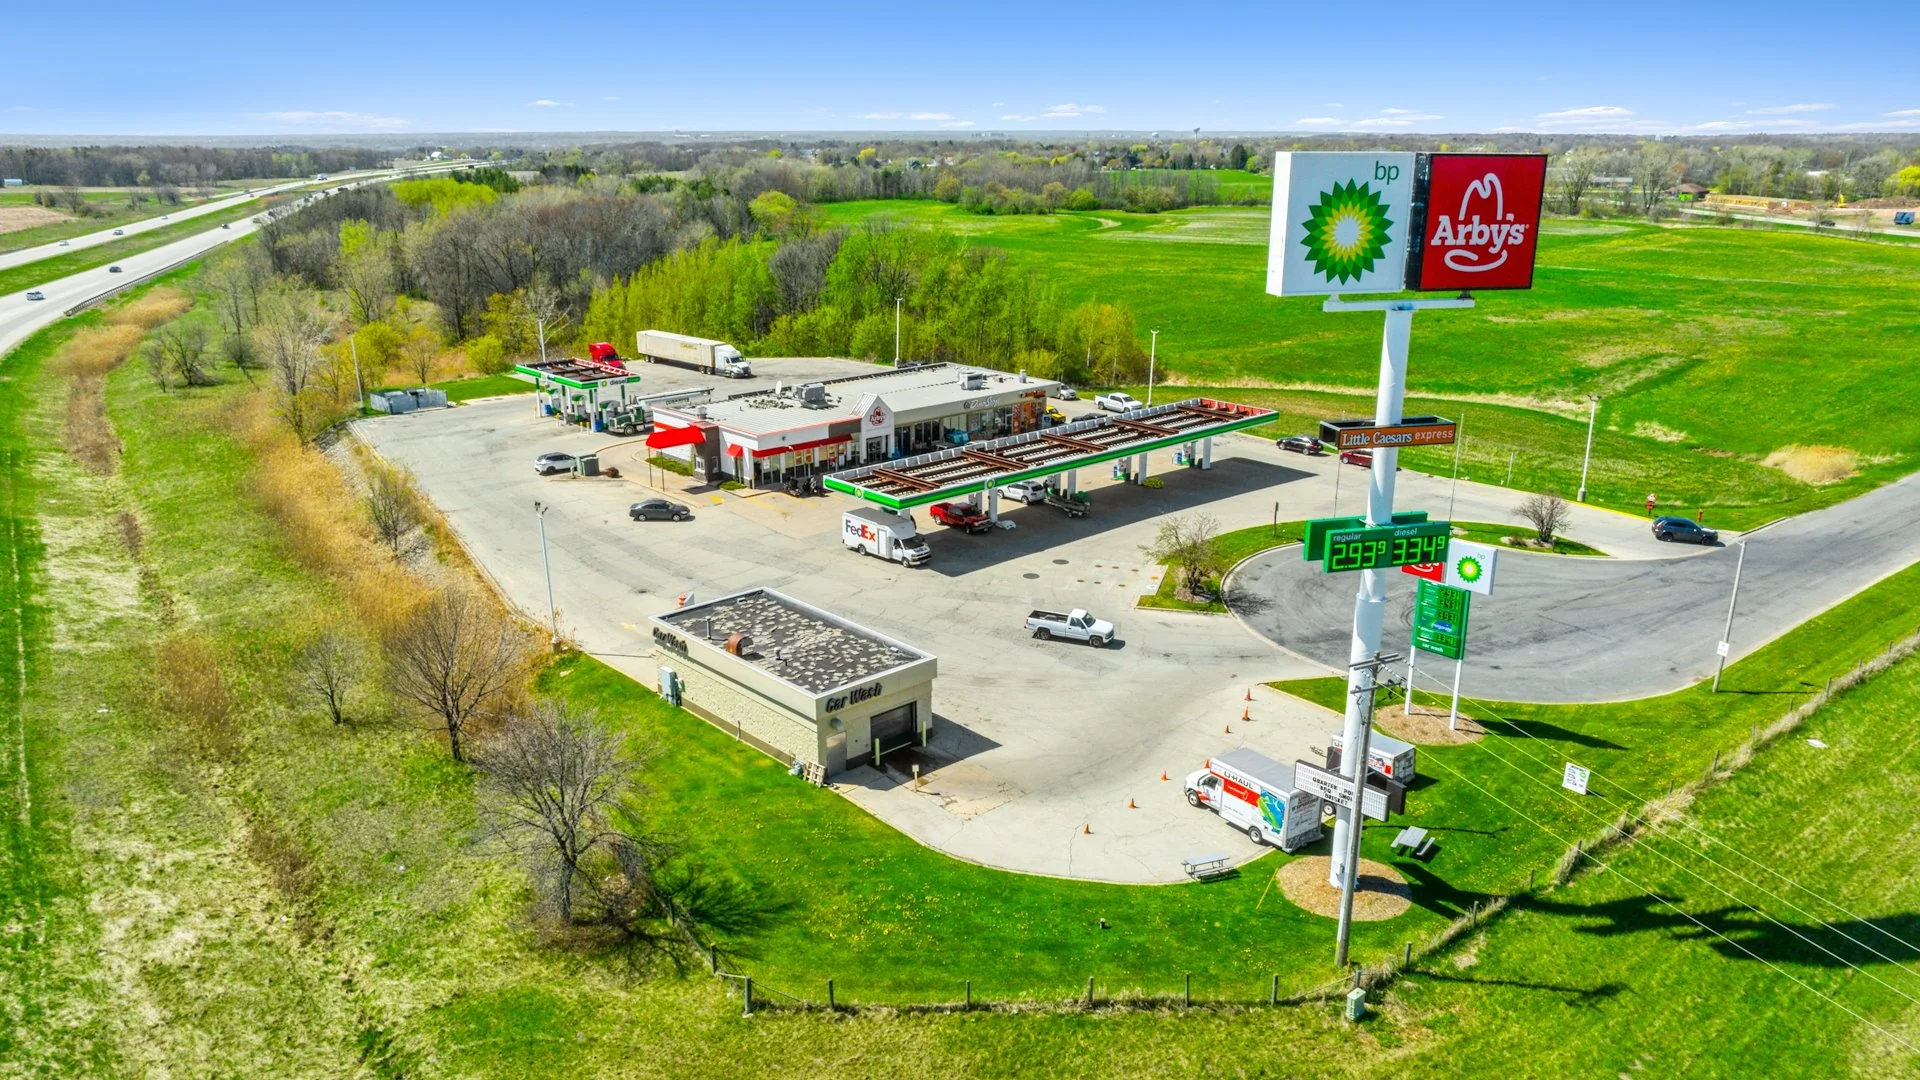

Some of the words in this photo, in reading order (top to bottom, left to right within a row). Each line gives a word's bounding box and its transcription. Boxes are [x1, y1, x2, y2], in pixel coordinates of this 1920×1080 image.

[1374, 160, 1400, 185] bp
[1430, 213, 1525, 254] Arby's
[1342, 433, 1370, 446] Little
[1372, 431, 1413, 445] Caesars
[1415, 430, 1453, 441] express
[845, 519, 876, 542] FedEx
[1333, 533, 1362, 543] regular
[1394, 528, 1418, 537] diesel
[1477, 552, 1486, 560] bp
[826, 696, 848, 713] Car
[850, 682, 883, 705] Wash
[1223, 770, 1254, 790] U-HAUL
[1312, 776, 1338, 791] QUARTER
